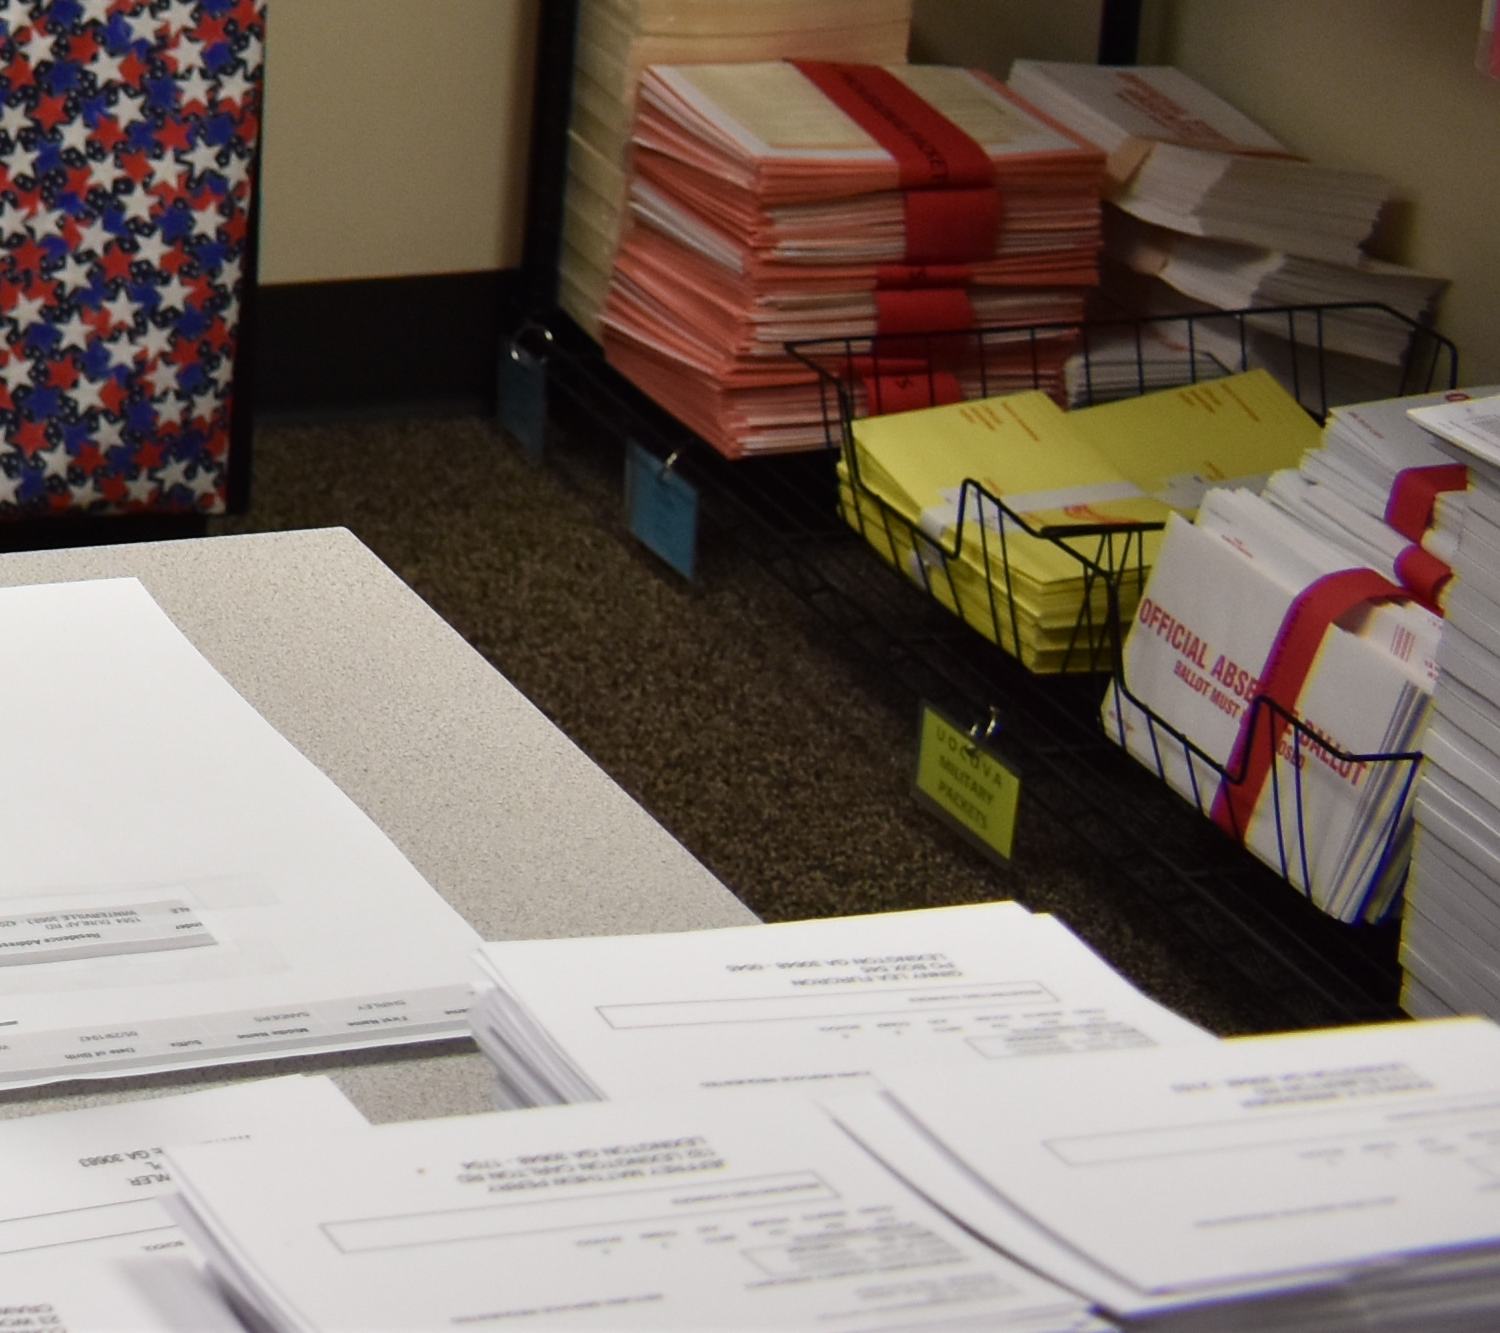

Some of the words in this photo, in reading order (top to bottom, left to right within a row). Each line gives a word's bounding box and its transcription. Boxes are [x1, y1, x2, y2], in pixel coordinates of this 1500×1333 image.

[1137, 597, 1209, 670] OFFICIAL
[1173, 659, 1211, 694] BALLOT
[1209, 684, 1242, 719] MUST
[43, 932, 101, 948] Residence
